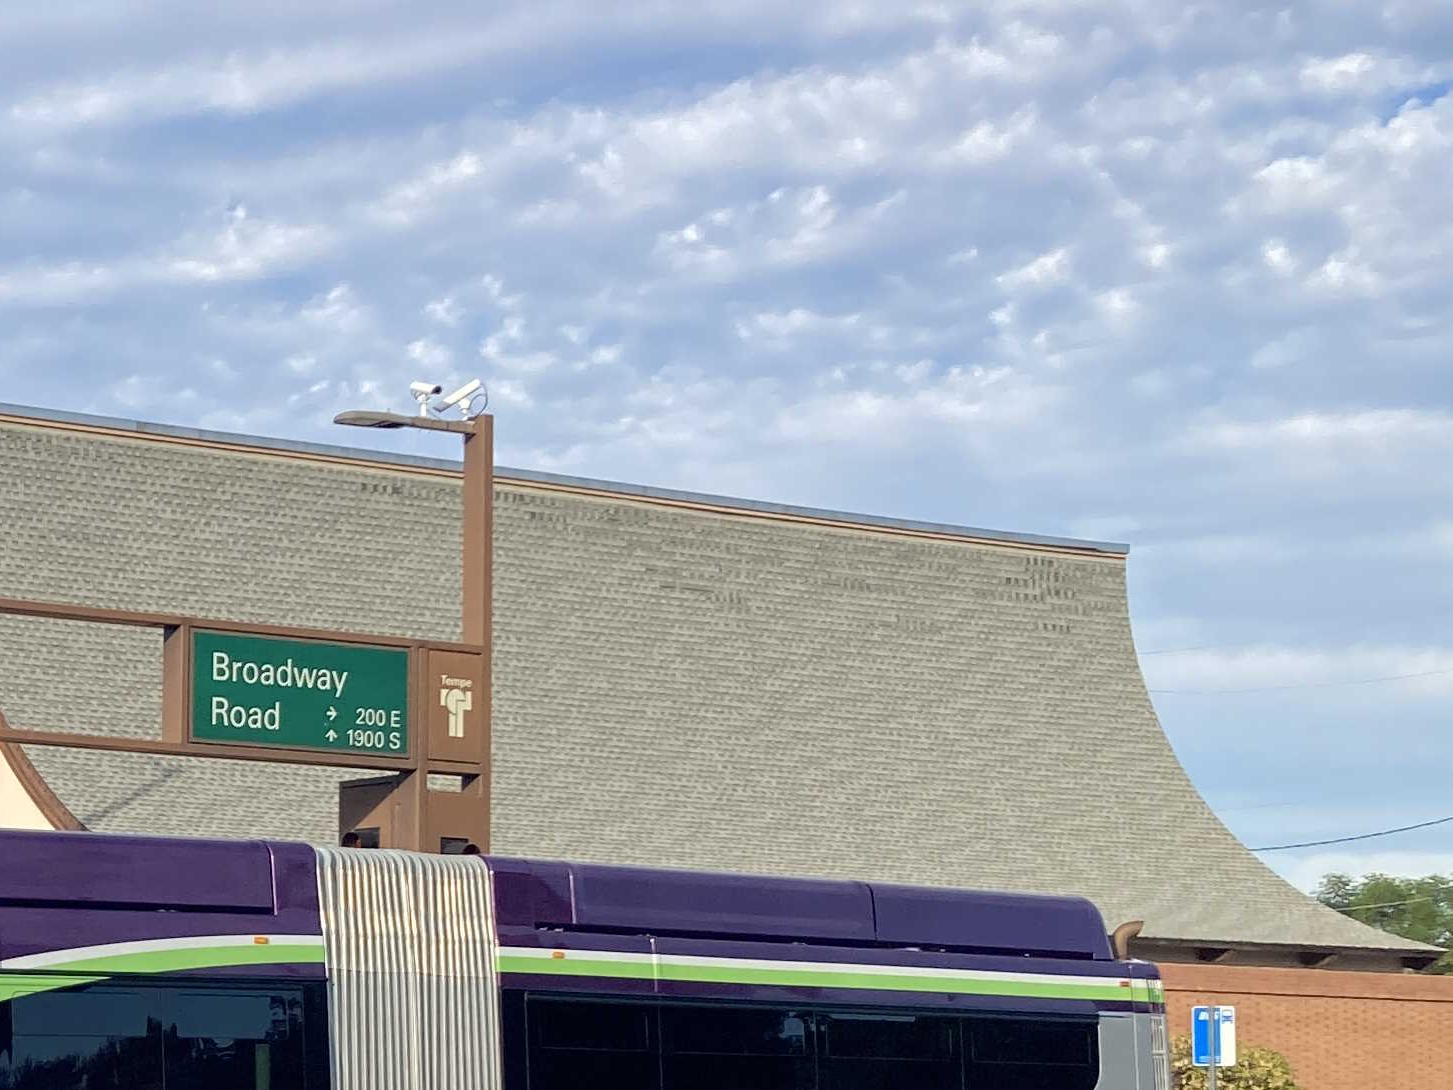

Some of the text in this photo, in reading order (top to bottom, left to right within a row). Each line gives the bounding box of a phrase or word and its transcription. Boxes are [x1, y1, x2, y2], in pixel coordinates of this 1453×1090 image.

[212, 652, 348, 698] Broadway
[440, 674, 473, 689] Tempe
[211, 696, 281, 731] Road
[355, 708, 401, 728] 200 E
[346, 729, 401, 749] 1900 S
